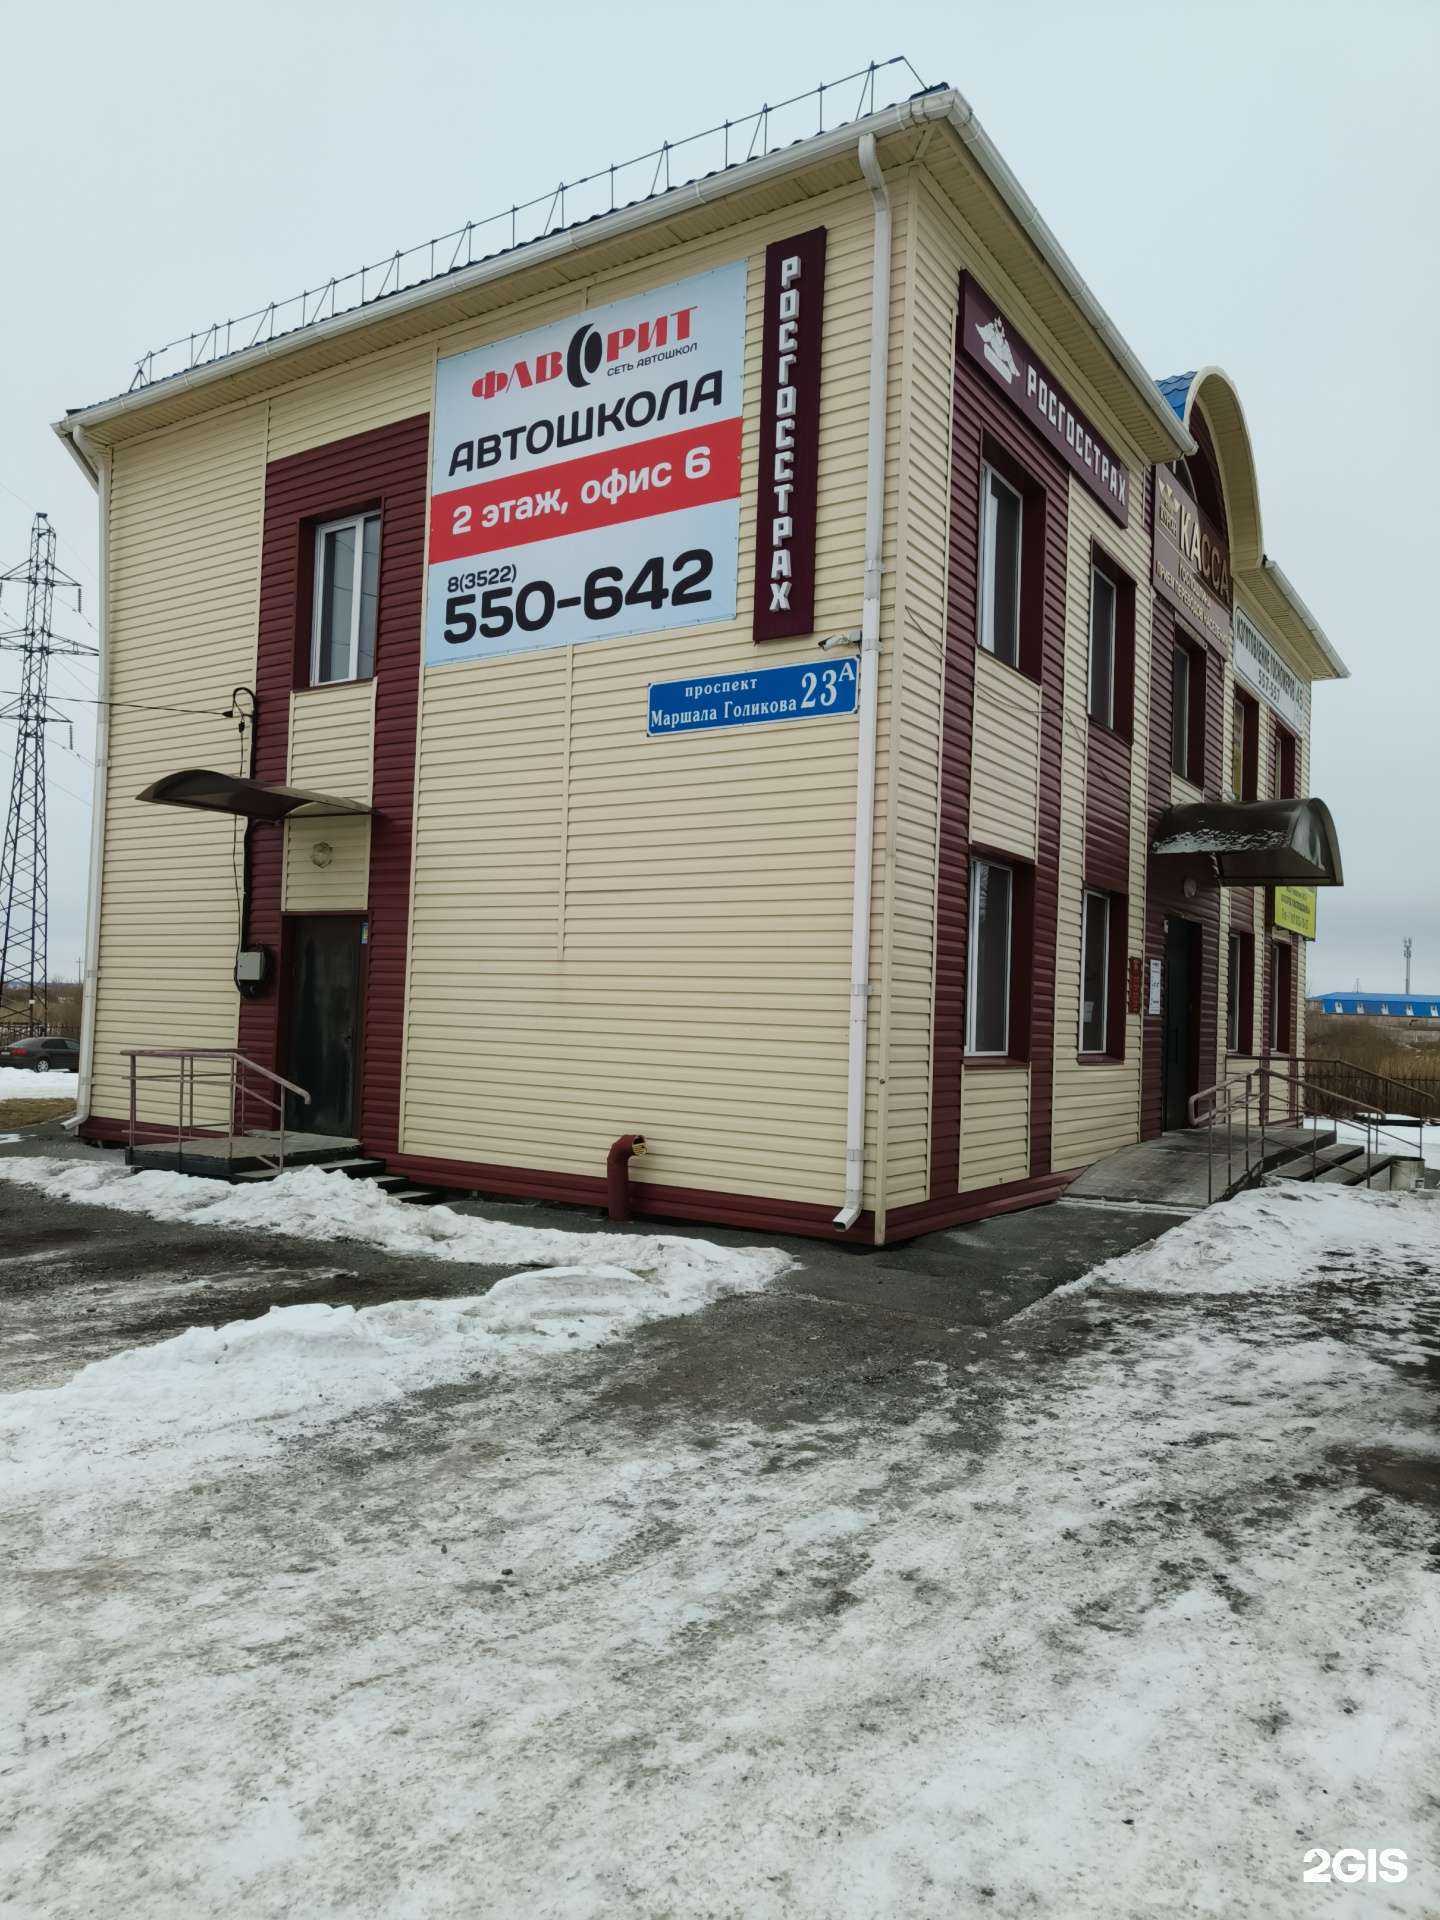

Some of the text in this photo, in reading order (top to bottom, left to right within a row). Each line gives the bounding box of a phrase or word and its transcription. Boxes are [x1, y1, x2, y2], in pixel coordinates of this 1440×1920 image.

[606, 342, 698, 377] СЕТЬ АВТОШКОЛ
[448, 369, 723, 477] АВТОШКОЛА
[770, 254, 800, 612] РОСГОССТРАХ
[1026, 364, 1126, 506] РОСГОССТРАХ
[452, 446, 711, 535] 2 этаж, офис 6
[443, 548, 714, 645] 550-642
[447, 563, 517, 593] 8(3522)
[1180, 503, 1232, 606] КАССА
[651, 697, 797, 729] Маршала Голикова
[684, 677, 758, 699] проспект
